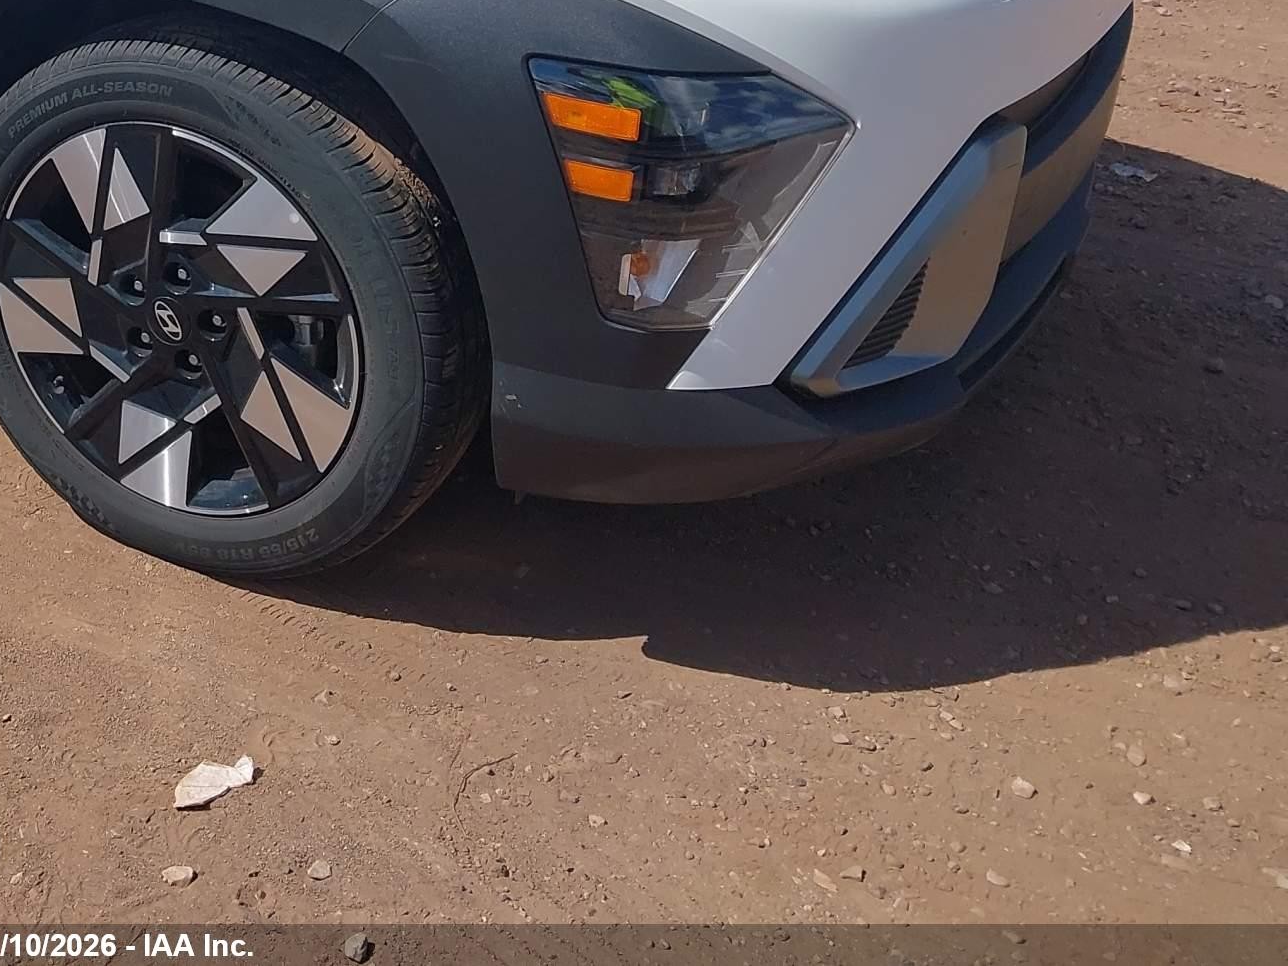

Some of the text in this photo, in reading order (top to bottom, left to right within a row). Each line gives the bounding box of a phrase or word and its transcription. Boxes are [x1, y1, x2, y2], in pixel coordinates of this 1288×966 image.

[7, 81, 173, 138] PREMIUM ALL-SEASON
[258, 527, 319, 559] 215/55
